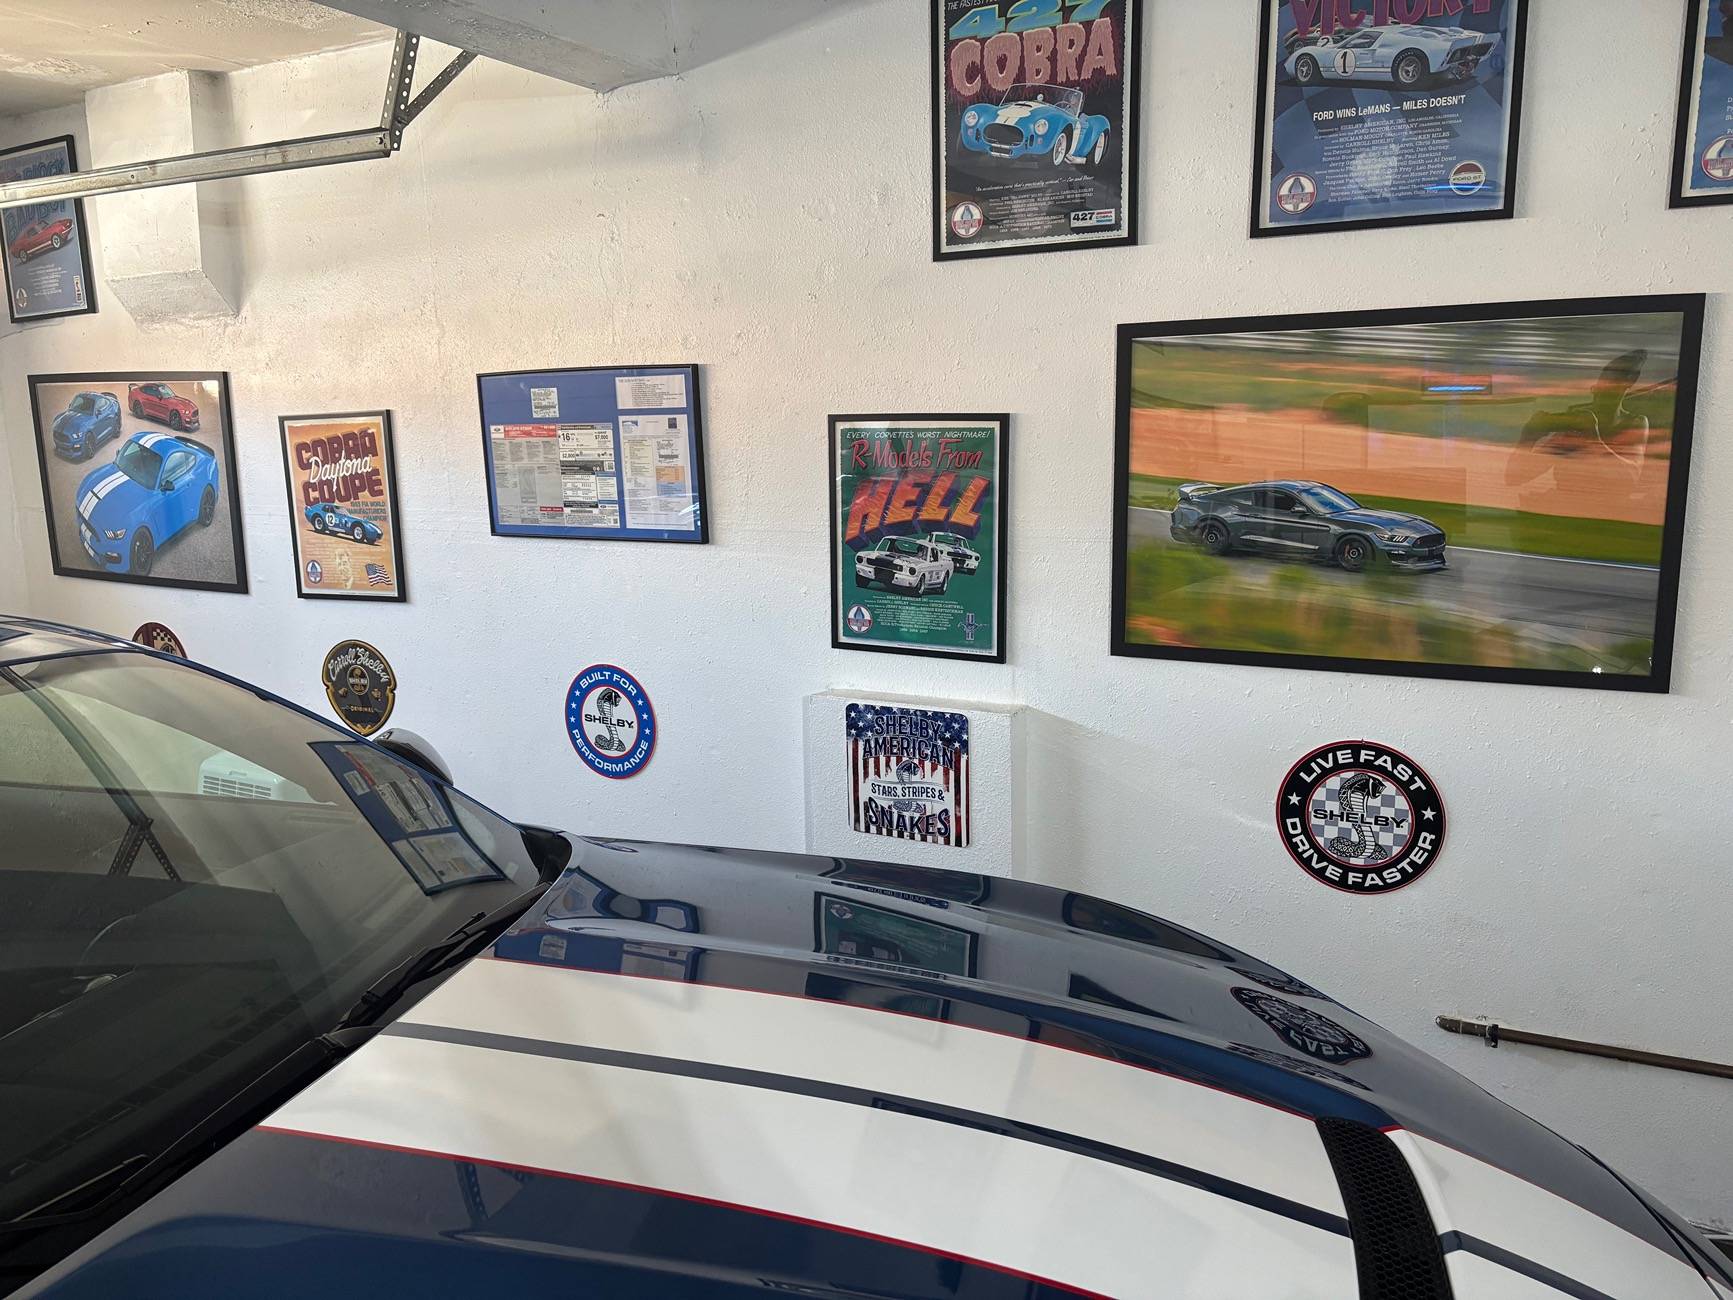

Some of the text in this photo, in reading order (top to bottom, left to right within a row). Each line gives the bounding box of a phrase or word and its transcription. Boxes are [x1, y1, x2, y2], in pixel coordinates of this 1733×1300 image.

[948, 1, 959, 10] THE
[950, 0, 1110, 40] 427
[1292, 0, 1490, 37] VICO
[951, 17, 1117, 96] COBRA
[1340, 51, 1348, 74] 1
[1313, 94, 1466, 121] FORD WINS LeMANS MILES DOESN'T
[1073, 212, 1095, 221] 427
[295, 427, 379, 470] COBRA
[561, 432, 570, 441] 16
[847, 431, 870, 439] EVERY
[944, 430, 990, 438] NIGHTMARE!
[309, 449, 373, 492] Daytona
[849, 438, 983, 471] R-Models From
[302, 468, 384, 506] COUPE
[327, 514, 334, 525] 12
[845, 470, 990, 551] HELL
[328, 647, 389, 682] Carroll Shelby
[580, 671, 637, 696] BUILT FOR
[350, 705, 374, 713] ORIGINAL
[584, 714, 633, 728] SHELBY
[874, 715, 942, 739] SHELBY
[572, 729, 648, 772] PERFORMANCE
[862, 735, 955, 770] AMERICAN
[1299, 749, 1426, 793] LIVE FAST
[871, 782, 945, 801] STARS, STRIPES &
[868, 796, 951, 837] SNAKES
[1313, 809, 1407, 828] SHELBY
[1286, 817, 1436, 887] DRIVE FASTER
